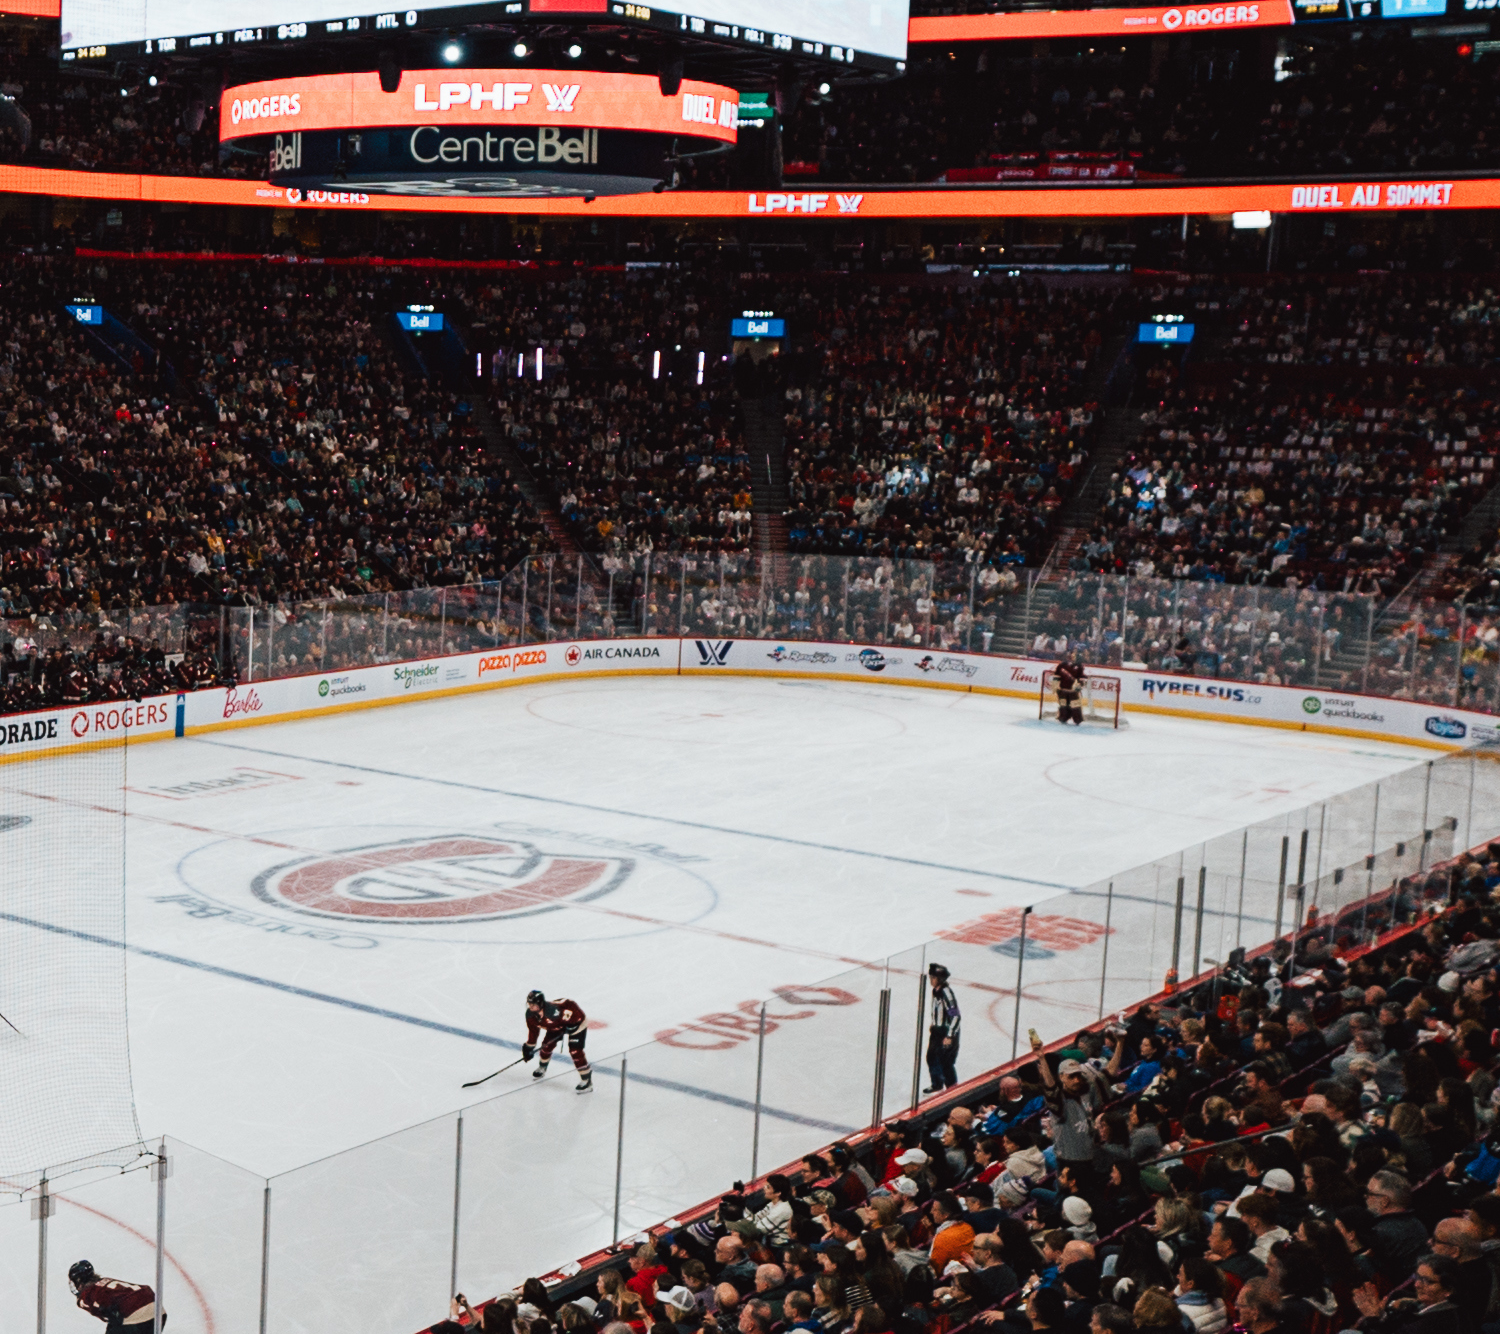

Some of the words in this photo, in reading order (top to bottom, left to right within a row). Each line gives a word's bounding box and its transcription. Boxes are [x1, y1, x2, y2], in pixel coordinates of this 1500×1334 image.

[1185, 5, 1259, 26] ROGERS
[278, 22, 307, 39] 9:39
[243, 94, 301, 119] ROGERS
[415, 83, 532, 111] LPHF
[683, 93, 716, 124] DUEL
[410, 126, 598, 164] CentreBell
[749, 193, 828, 213] LPHF
[1291, 185, 1343, 209] DUEL
[1350, 184, 1379, 207] AU
[1385, 181, 1454, 206] SOMMET
[746, 319, 768, 334] Bell
[1156, 324, 1178, 340] Bell
[584, 647, 602, 660] AIR
[604, 645, 660, 659] CANADA
[394, 664, 439, 682] Schneider
[478, 653, 511, 677] pizza
[513, 649, 547, 672] pizza
[1010, 666, 1039, 684] Tims
[330, 683, 366, 698] quickbooks
[223, 688, 264, 719] Barbie
[94, 703, 168, 731] ROGERS
[1323, 707, 1385, 723] quickbooks
[1427, 721, 1466, 738] Royale
[654, 999, 816, 1051] CIBC
